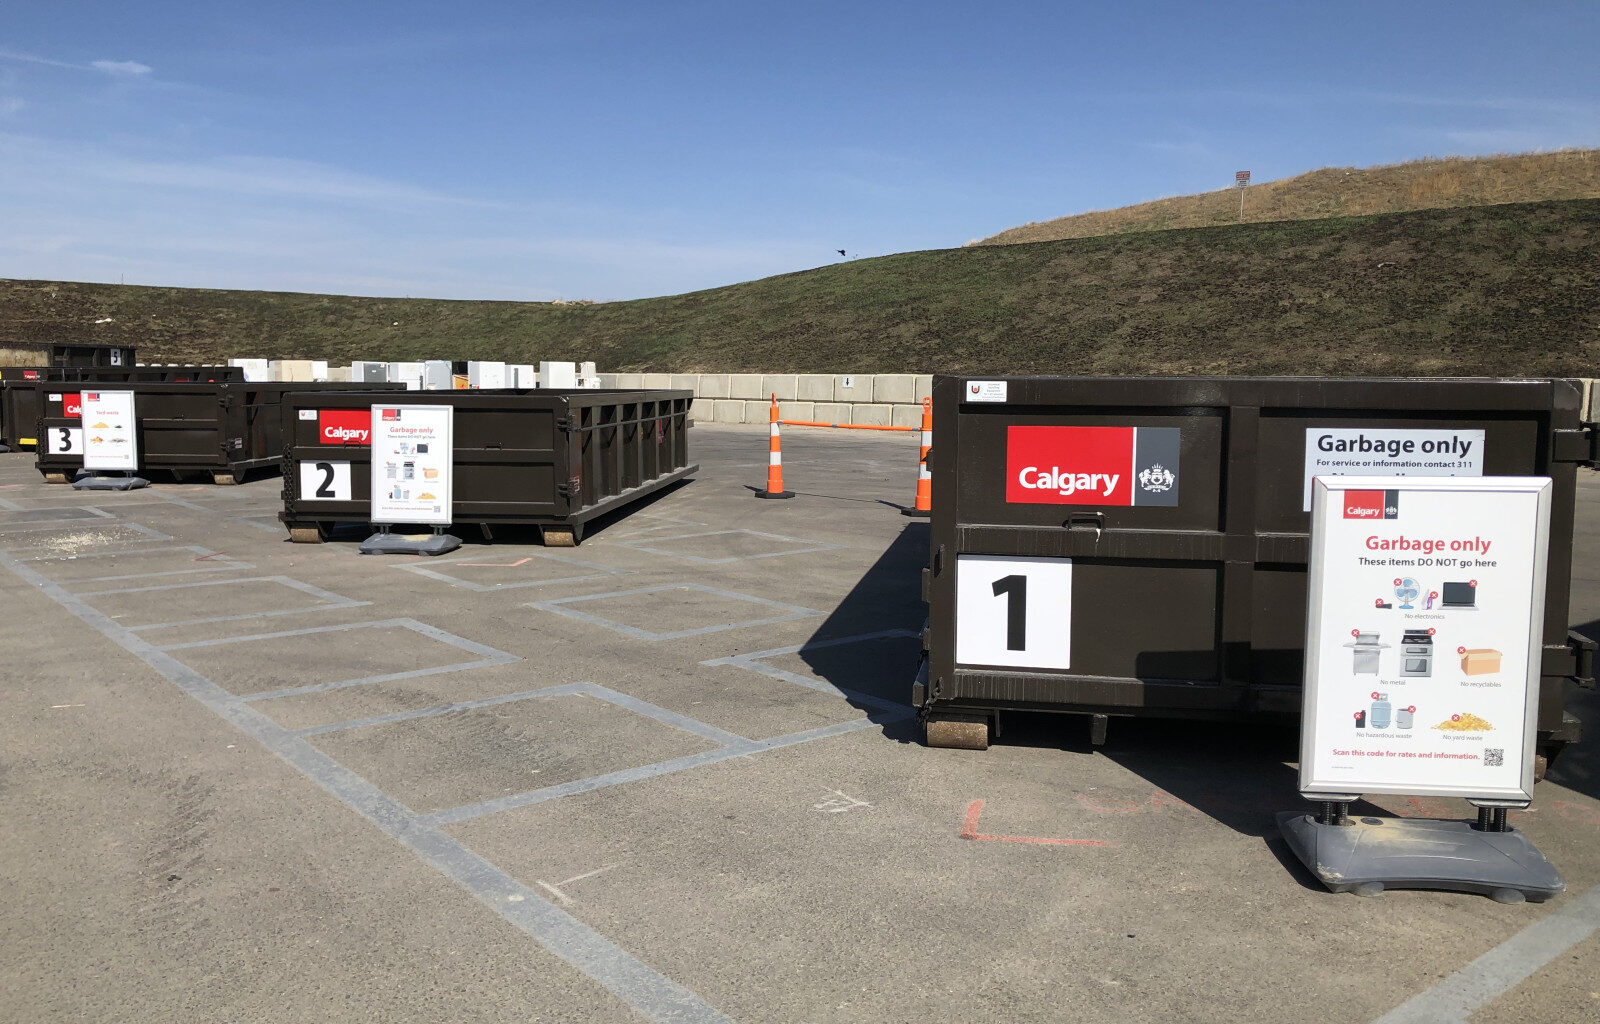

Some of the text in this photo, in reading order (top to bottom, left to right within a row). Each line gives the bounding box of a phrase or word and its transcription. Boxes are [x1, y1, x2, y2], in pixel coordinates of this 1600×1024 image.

[113, 349, 118, 363] 5
[324, 426, 368, 441] Calgary
[390, 426, 434, 435] Garbage only
[59, 427, 72, 452] 3
[1317, 434, 1473, 459] Garbage only
[1316, 459, 1330, 467] For
[1331, 459, 1360, 467] service
[1373, 459, 1422, 468] information
[1423, 460, 1455, 468] contact
[316, 462, 336, 498] 2
[1018, 466, 1120, 497] Calgary
[1346, 506, 1380, 517] Calgary
[1365, 535, 1492, 556] Garbage only
[1358, 557, 1498, 569] These items DO NOT go here
[991, 574, 1027, 652] 1
[1470, 681, 1502, 689] recyclables
[1332, 748, 1350, 756] Scan
[1351, 749, 1366, 757] this
[1366, 750, 1385, 758] code
[1433, 752, 1481, 760] information.
